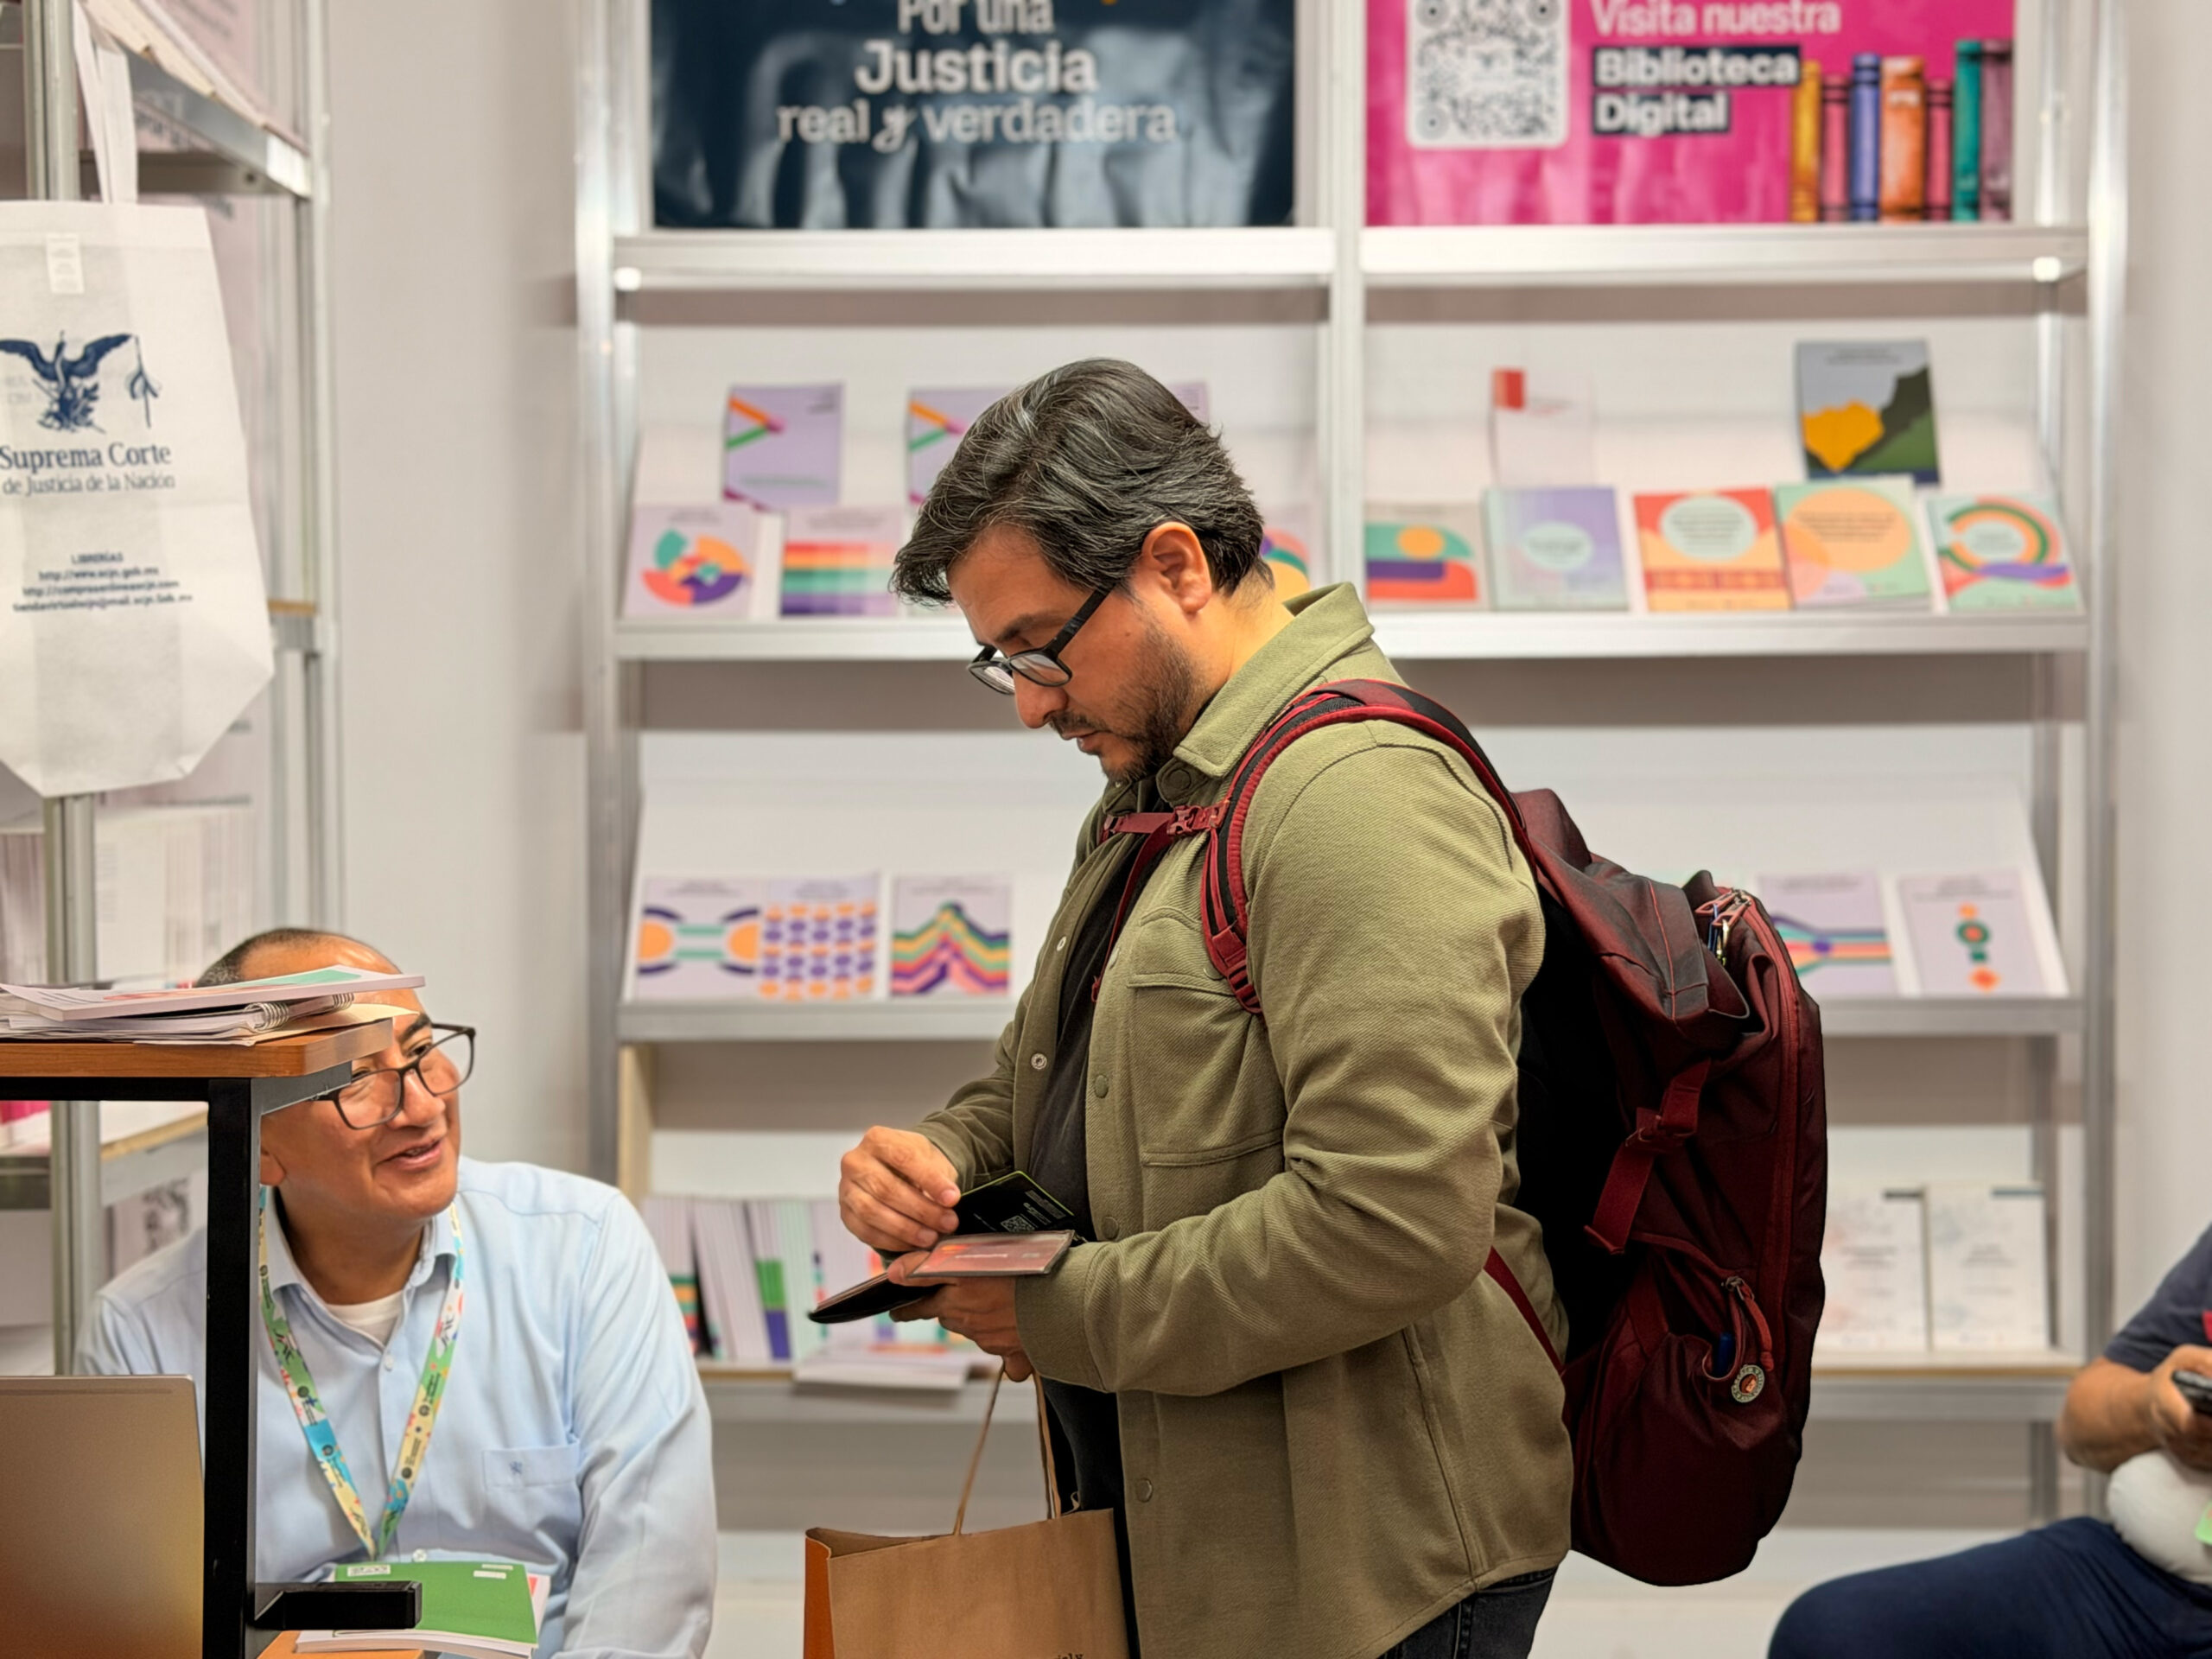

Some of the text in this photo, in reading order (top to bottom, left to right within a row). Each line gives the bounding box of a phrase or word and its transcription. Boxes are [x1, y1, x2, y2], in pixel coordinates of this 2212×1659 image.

[898, 0, 1056, 34] Por una
[1590, 0, 1841, 35] Visita nuestra
[855, 39, 1098, 92] Justicia
[1595, 47, 1800, 86] Biblioteca
[777, 99, 1176, 153] real y verdadera
[1595, 92, 1727, 137] Digital
[0, 442, 171, 474] Suprema Corte
[3, 471, 175, 497] de Justicia de la Nación
